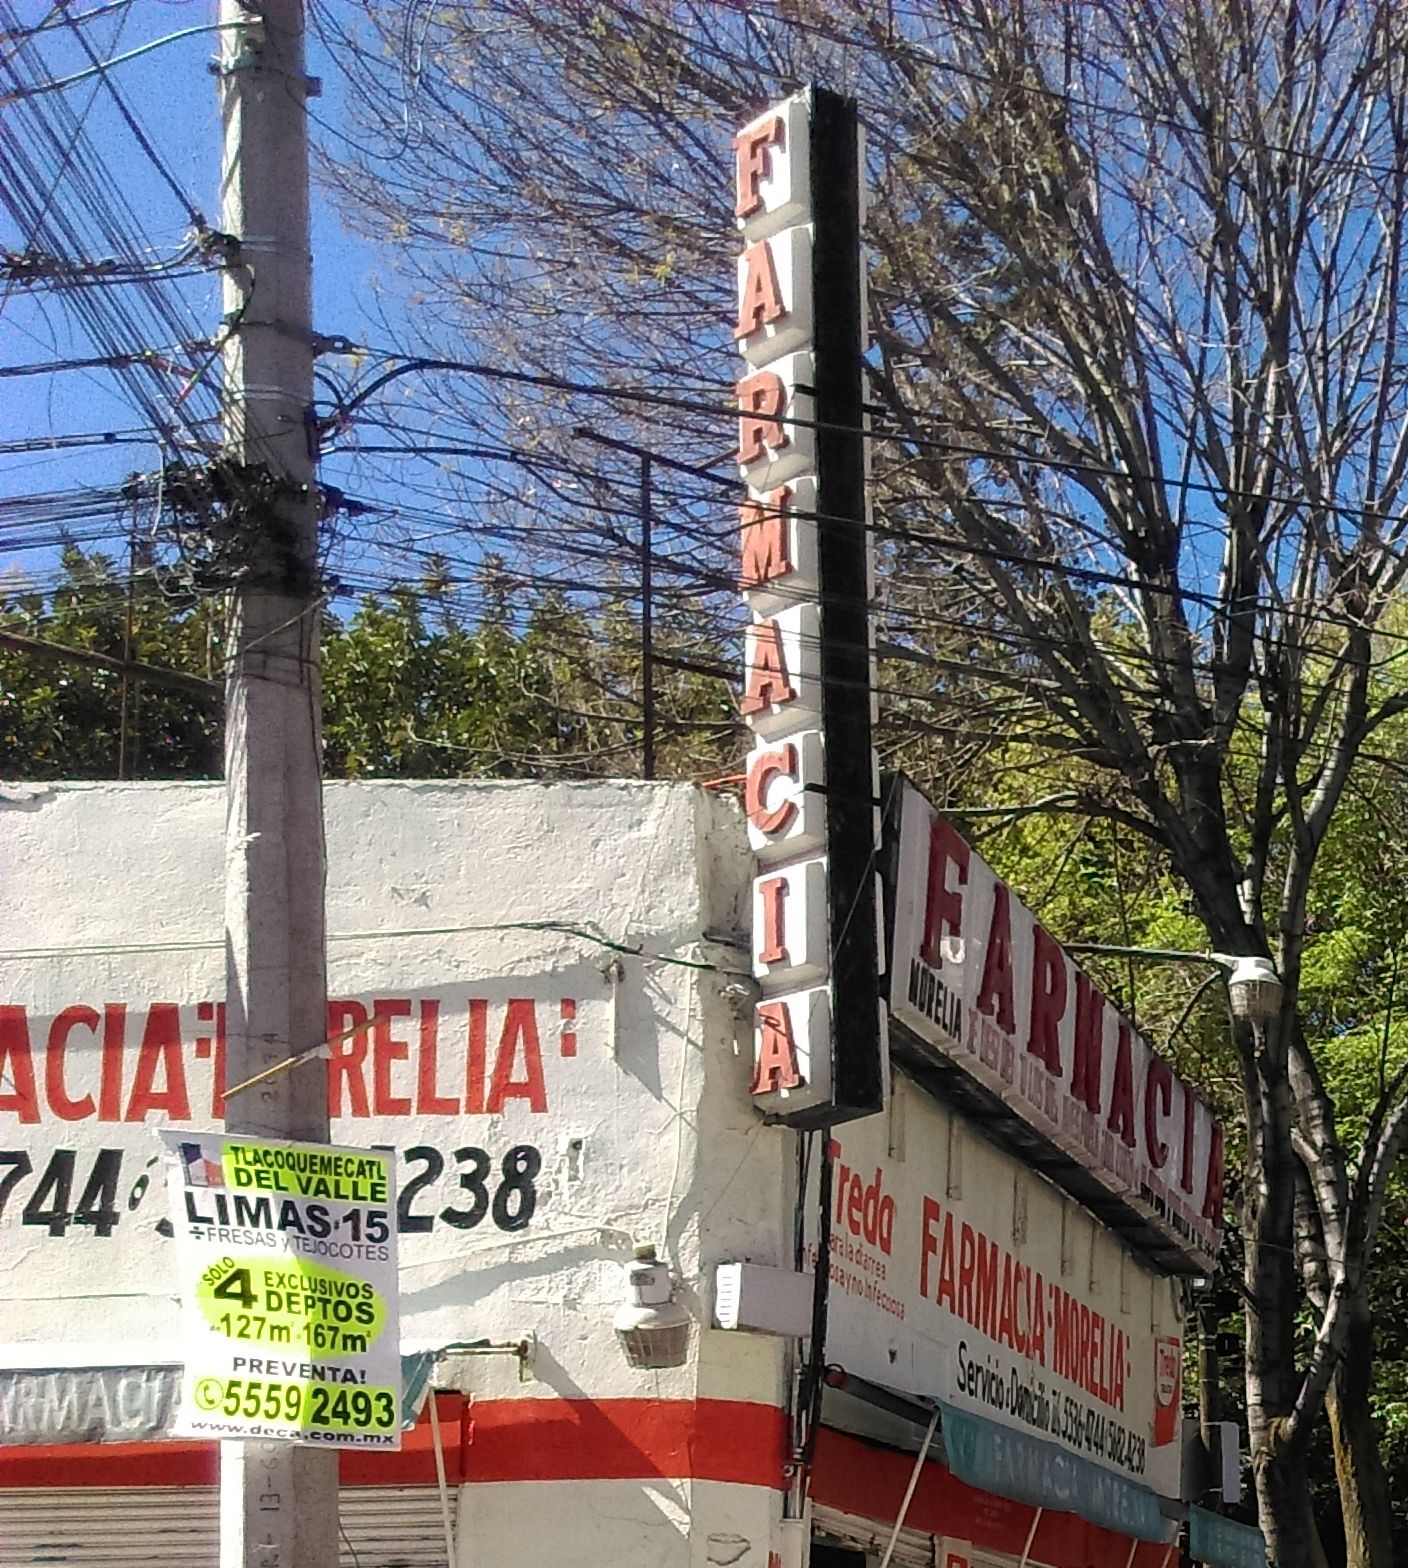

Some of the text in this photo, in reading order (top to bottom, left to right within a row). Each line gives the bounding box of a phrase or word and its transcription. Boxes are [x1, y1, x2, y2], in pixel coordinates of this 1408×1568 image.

[732, 113, 805, 1097] FARMACIA
[908, 957, 962, 1043] MORELIA
[919, 813, 1223, 1230] FARMACIA
[235, 1167, 388, 1203] DEL VALLE
[293, 1235, 390, 1261] TEJOCOTES
[202, 1256, 236, 1287] SÓLO
[213, 1267, 375, 1310] 4 EXCLUSIVOS
[920, 1194, 1046, 1368] FARMACIA
[265, 1290, 376, 1326] DEPTOS
[232, 1356, 366, 1385] PREVENTA!
[957, 1341, 1004, 1411] Servicio
[223, 1380, 395, 1429] 5559 2493
[190, 1420, 395, 1445] www.deca.com.mx
